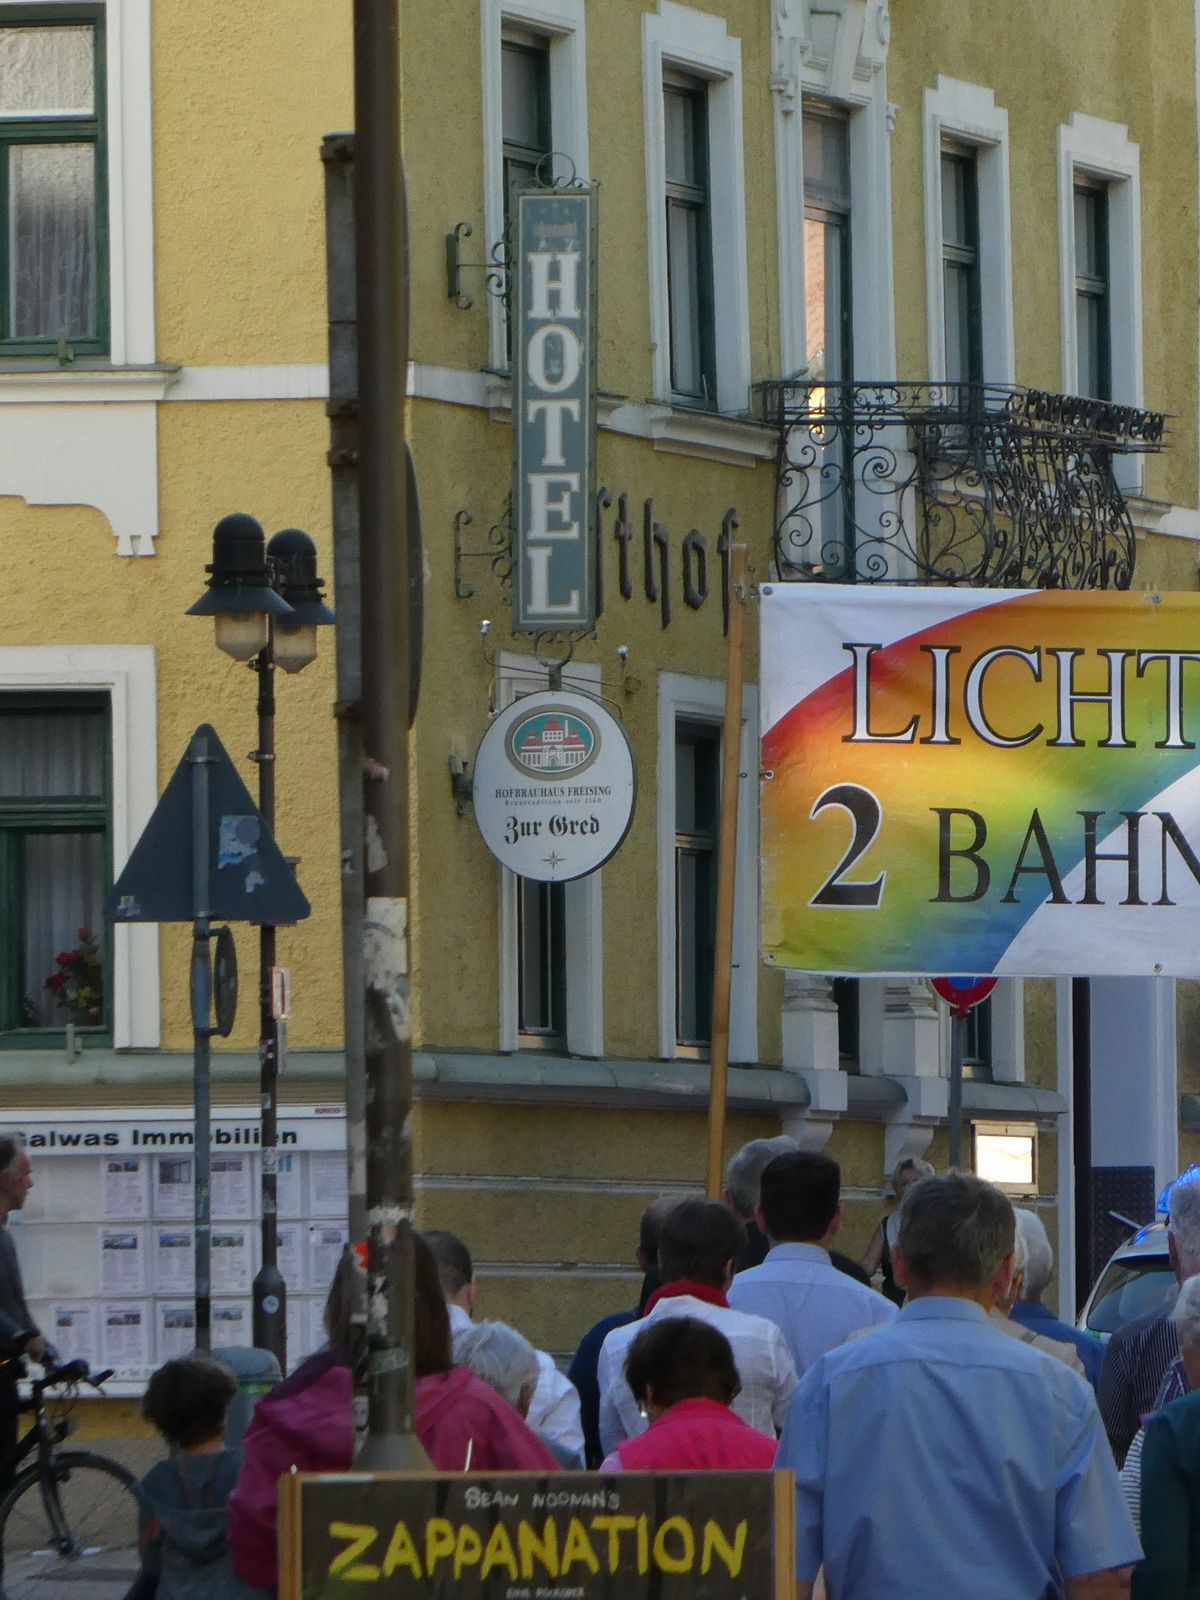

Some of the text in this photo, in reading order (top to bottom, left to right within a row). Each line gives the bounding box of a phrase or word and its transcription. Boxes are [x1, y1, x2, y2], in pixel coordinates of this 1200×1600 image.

[527, 251, 582, 615] HOTEL
[495, 785, 612, 798] HOFBRAUHAUS FREISING
[504, 814, 600, 845] Zur Gred
[807, 782, 888, 909] 2
[132, 1126, 298, 1146] Immbilin
[328, 1512, 748, 1581] ZAPPANATION
